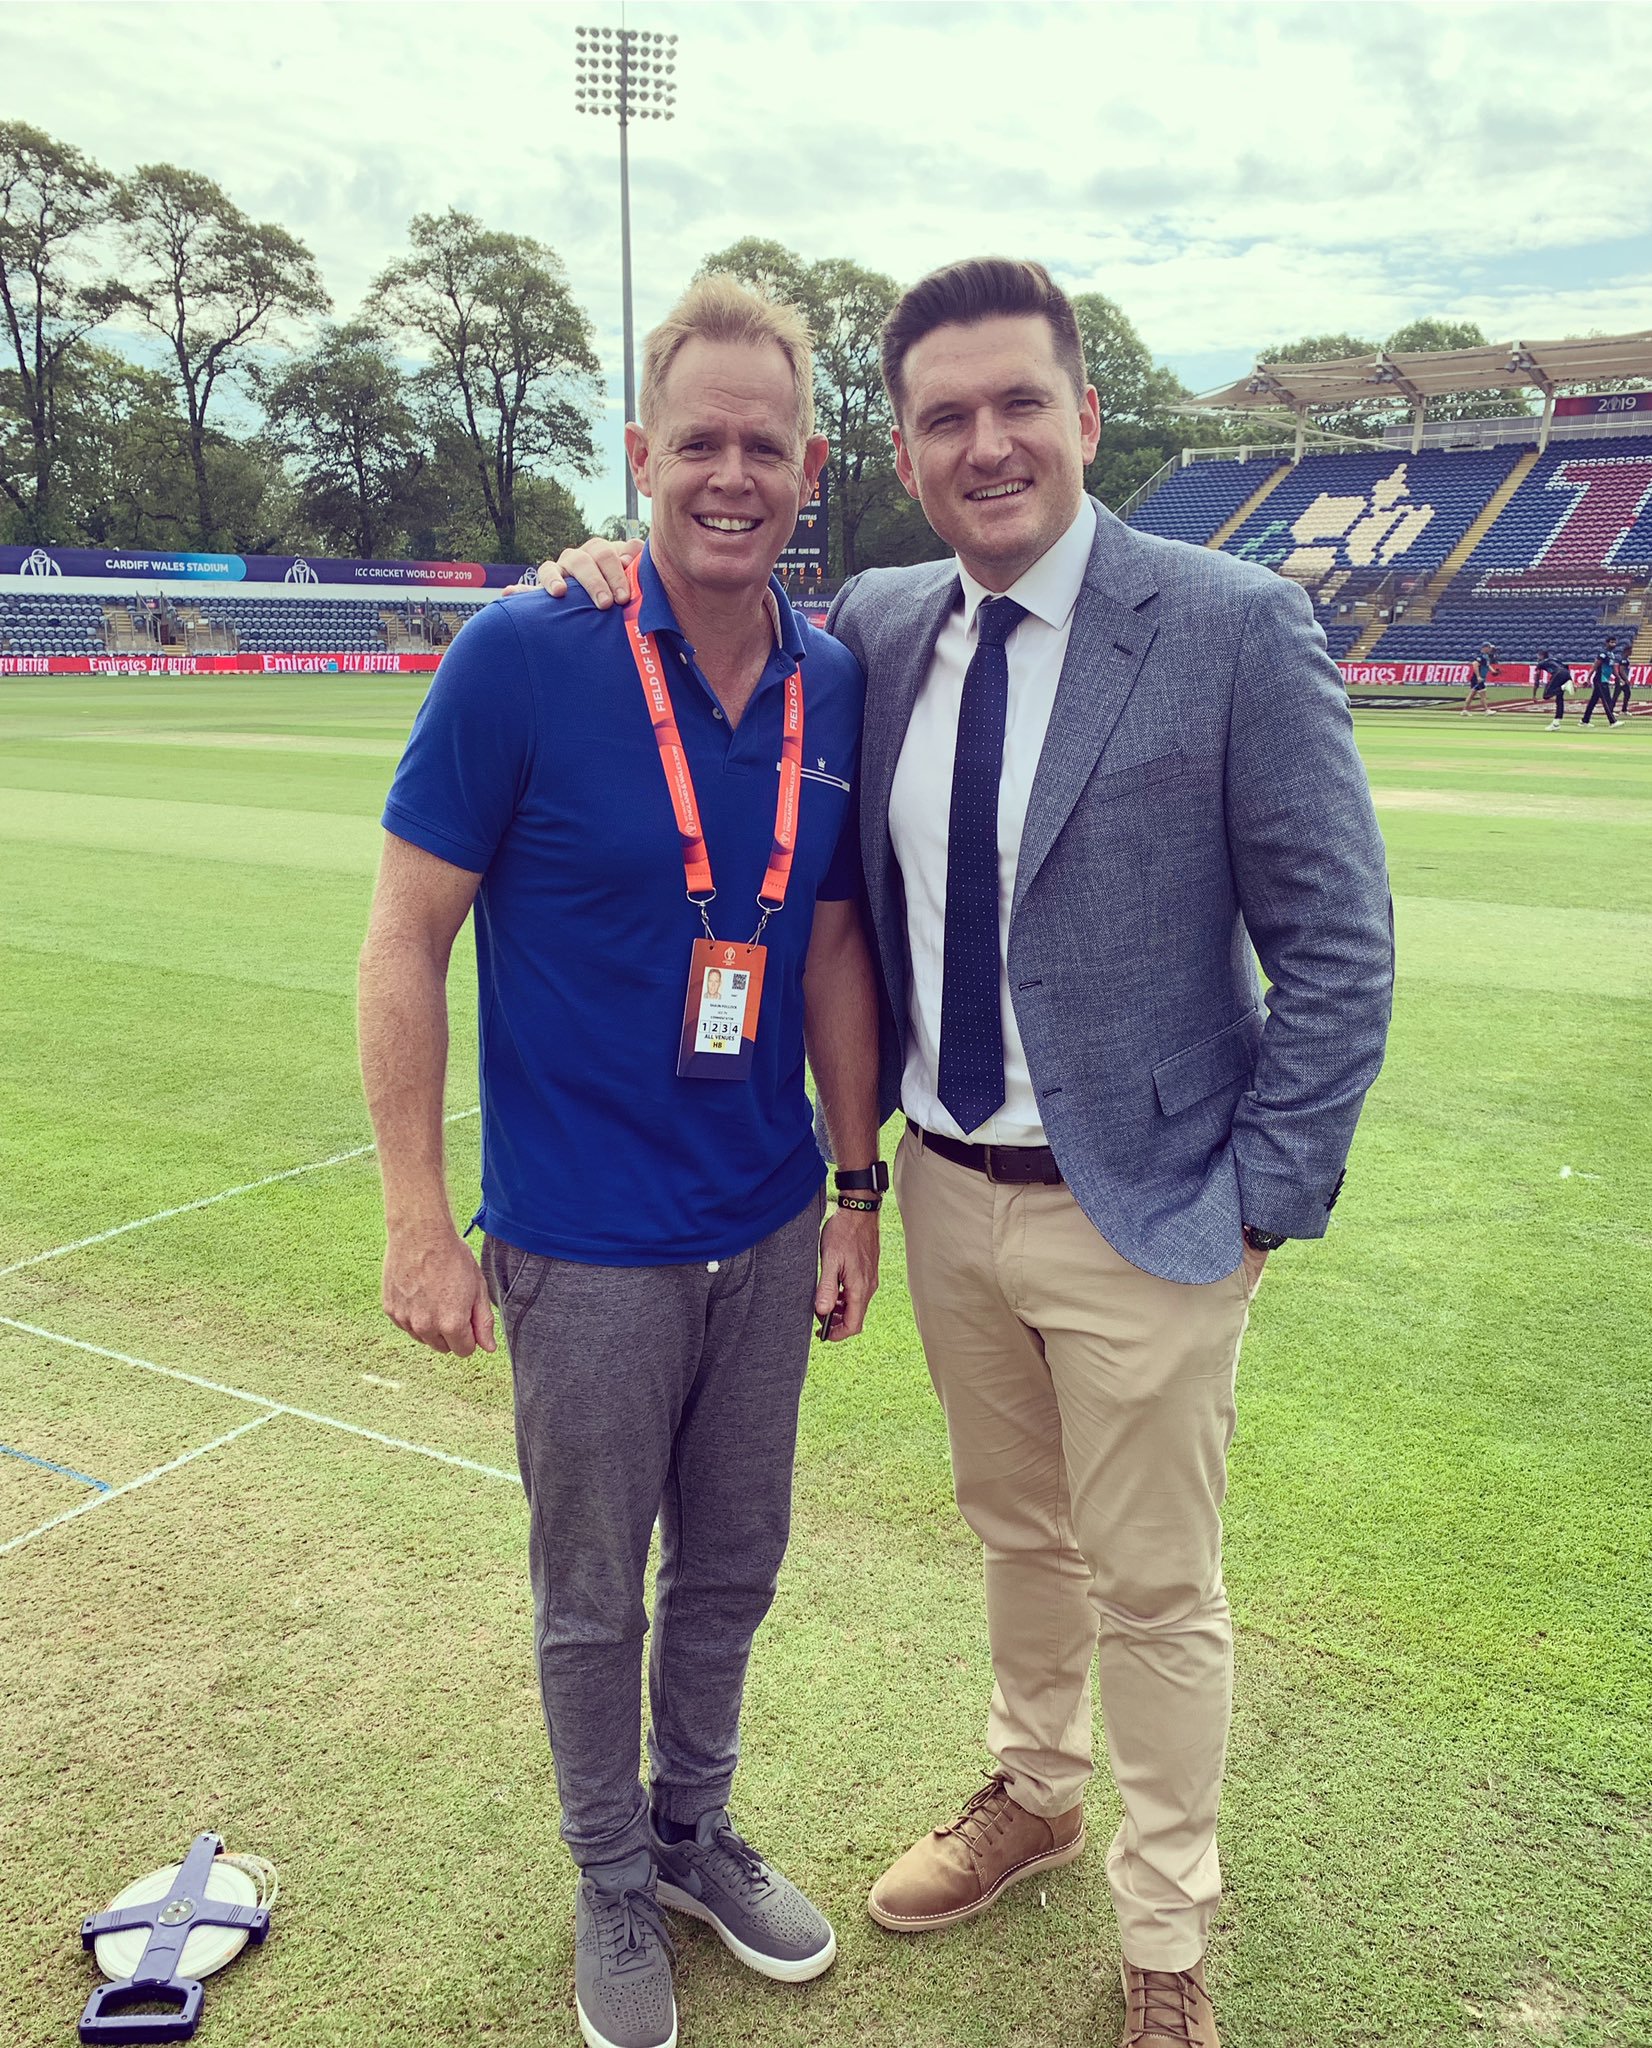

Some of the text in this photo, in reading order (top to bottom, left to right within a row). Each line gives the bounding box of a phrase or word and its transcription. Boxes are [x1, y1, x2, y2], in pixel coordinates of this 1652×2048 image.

[105, 559, 229, 573] CARDIFF WALES STADIUM
[355, 567, 473, 581] ICC CRICKET WORLD CUP 2019
[804, 600, 831, 608] GREATE
[0, 658, 49, 672] FLY BETTER
[89, 658, 197, 672] Emirates FLY BETTER
[342, 655, 361, 671] FLY
[363, 655, 400, 671] BETTER
[643, 657, 656, 674] OF
[1340, 664, 1471, 682] irates FLY BETTER
[1629, 666, 1652, 685] FLY
[649, 677, 666, 712] FIELD
[789, 679, 797, 696] OF
[790, 698, 798, 731] FIELD
[702, 1022, 738, 1034] 1 2 3 4
